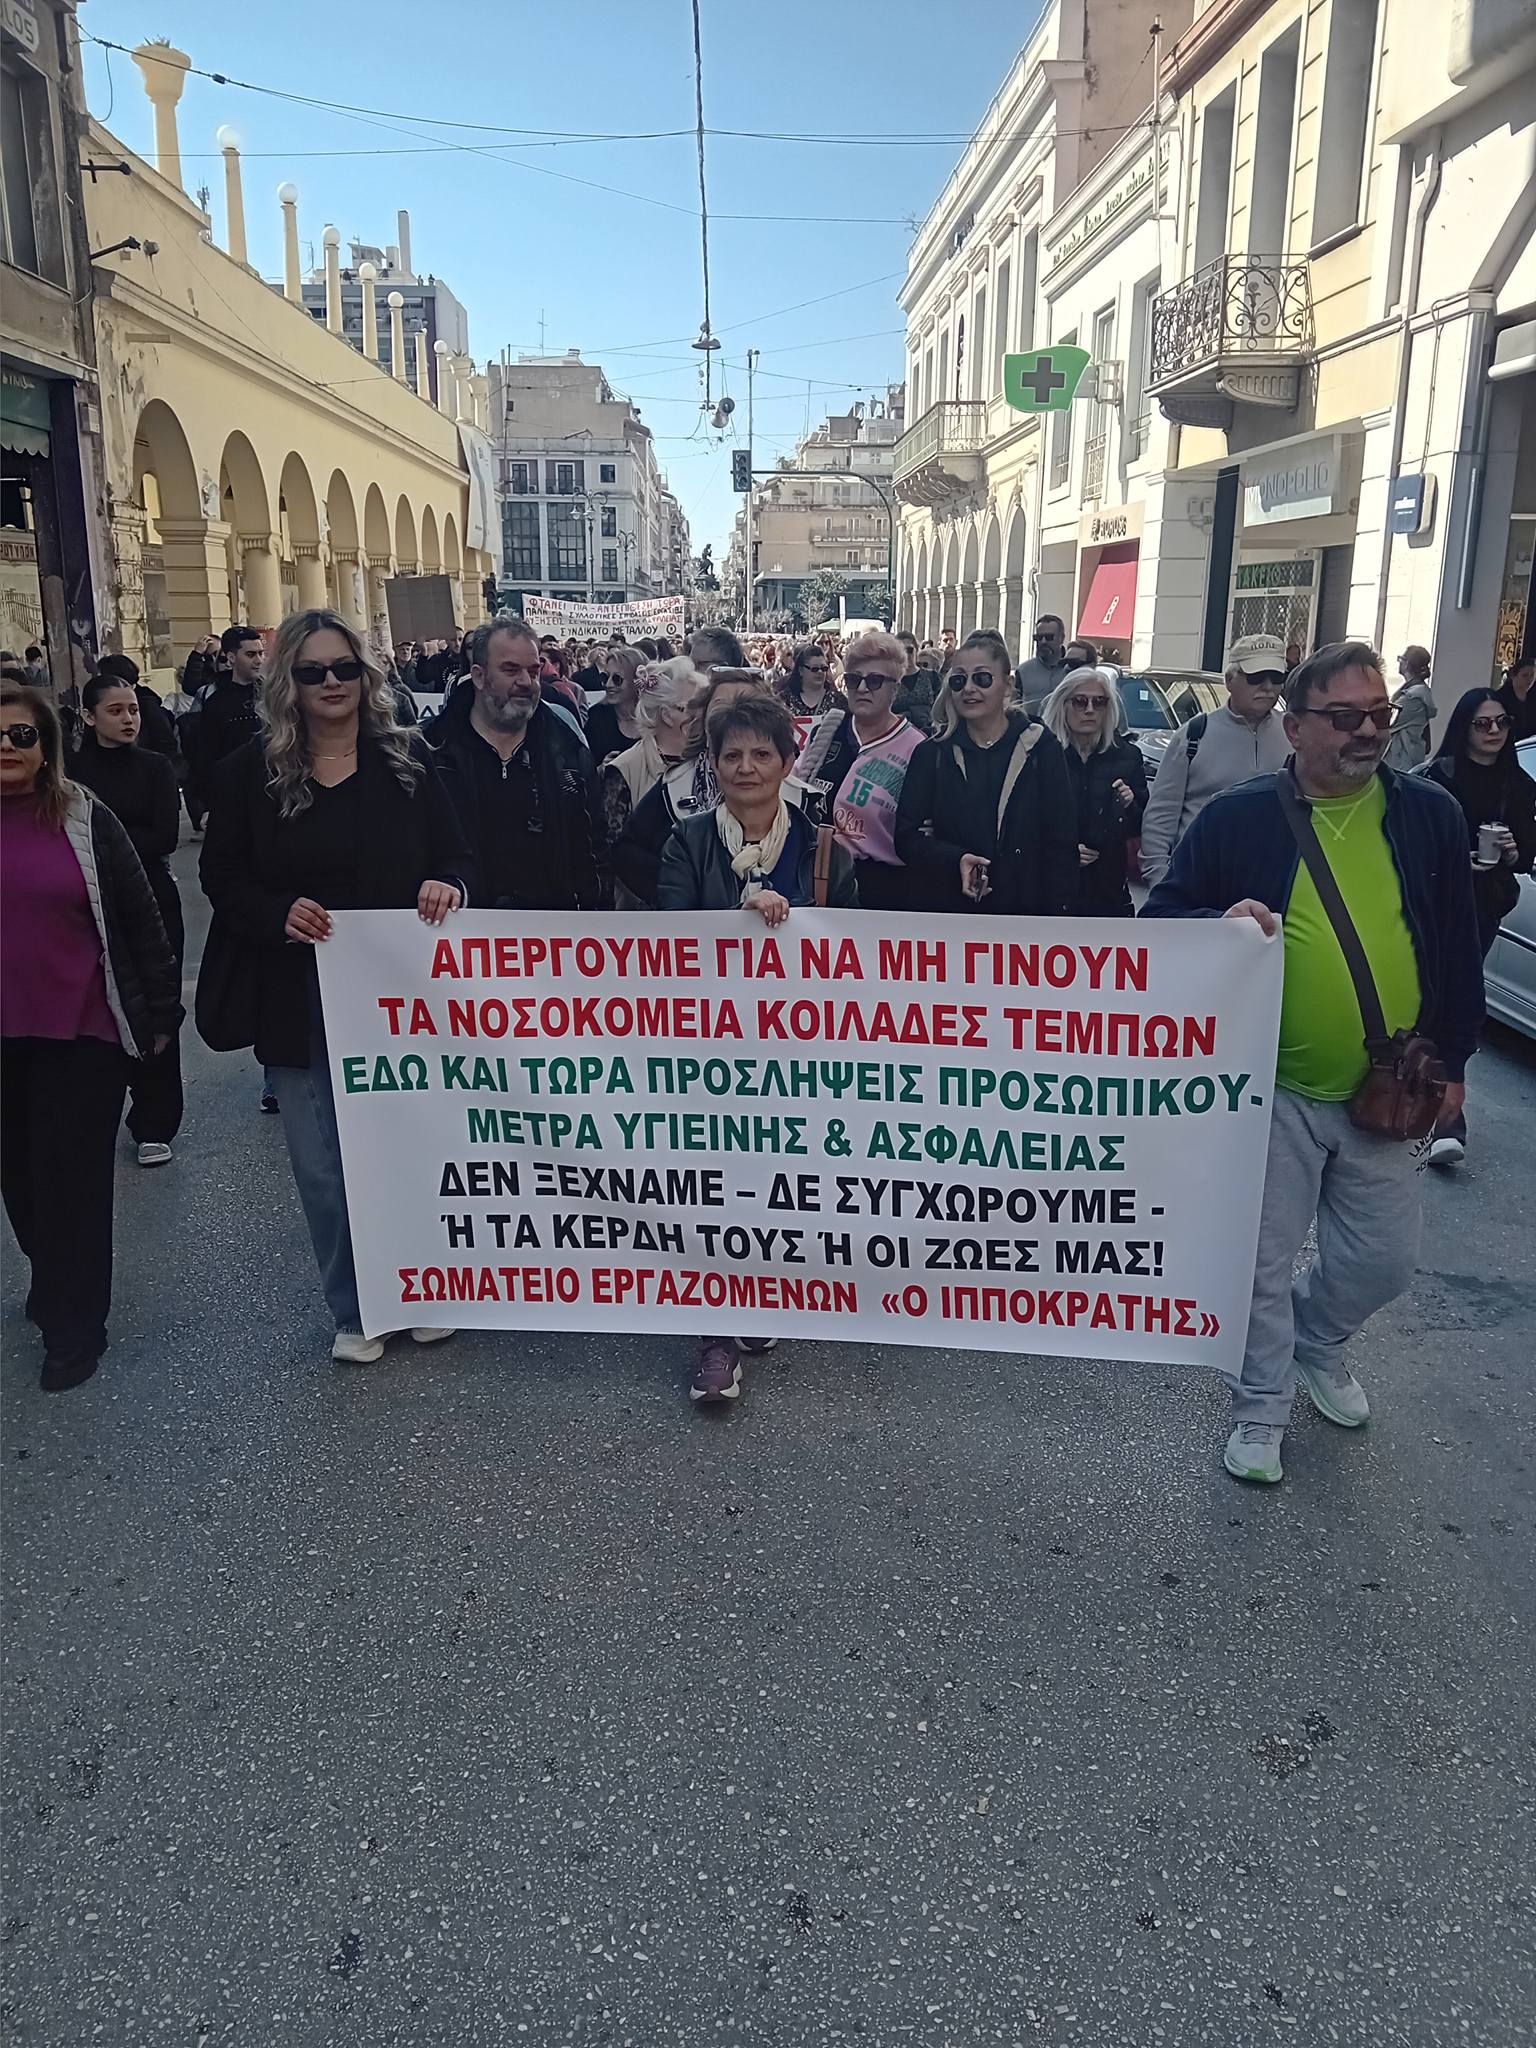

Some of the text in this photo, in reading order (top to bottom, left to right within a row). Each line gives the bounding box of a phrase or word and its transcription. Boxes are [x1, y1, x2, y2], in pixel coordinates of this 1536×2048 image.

[529, 597, 566, 611] ΦΤΑΝΕΙ
[573, 603, 588, 611] ΠΙΑ
[597, 601, 653, 613] ΑΝΤΕΠΙΘΕΣΗ
[658, 597, 681, 608] ΤΩΡΑ
[560, 625, 659, 637] ΣΥΝΔΙΚΑΤΟ ΜΕΤΑΛΛΟΥ
[846, 778, 874, 808] 15
[430, 937, 1149, 992] ΑΠΕΡΓΟΥΜΕ ΓΙΑ ΝΑ ΜΗ ΓΙΝΟΥΝ
[378, 997, 1217, 1059] ΤΑ ΝΟΣΟΚΟΜΕΙΑ ΚΟΙΛΑΔΕΣ ΤΕΜΠΩΝ
[342, 1053, 1265, 1118] ΕΔΩ ΚΑΙ ΤΩΡΑ ΠΡΟΣΛΗΨΕΙΣ ΠΡΟΣΩΠΙΚΟΥ-
[466, 1107, 1126, 1173] ΜΕΤΡΑ ΥΓΙΕΙΝΗΣ & ΑΣΦΑΛΕΙΑΣ
[438, 1161, 521, 1198] ΔΕΝ
[533, 1162, 726, 1208] ΞΕΧΝΑΜΕ
[767, 1172, 821, 1213] ΔΕ
[834, 1176, 1137, 1225] ΣΥΓΧΩΡΟΥΜΕ
[440, 1213, 1165, 1278] Ή ΤΑ ΚΕΡΔΗ ΤΟΥΣ Ή ΟΙ ΖΩΕΣ ΜΑΣ!
[398, 1266, 1221, 1339] ΣΩΜΑΤΕΙΟ ΕΡΓΑΖΟΜΕΝΩΝ «Ο ΙΠΠΟΚΡΑΤΗΣ»
